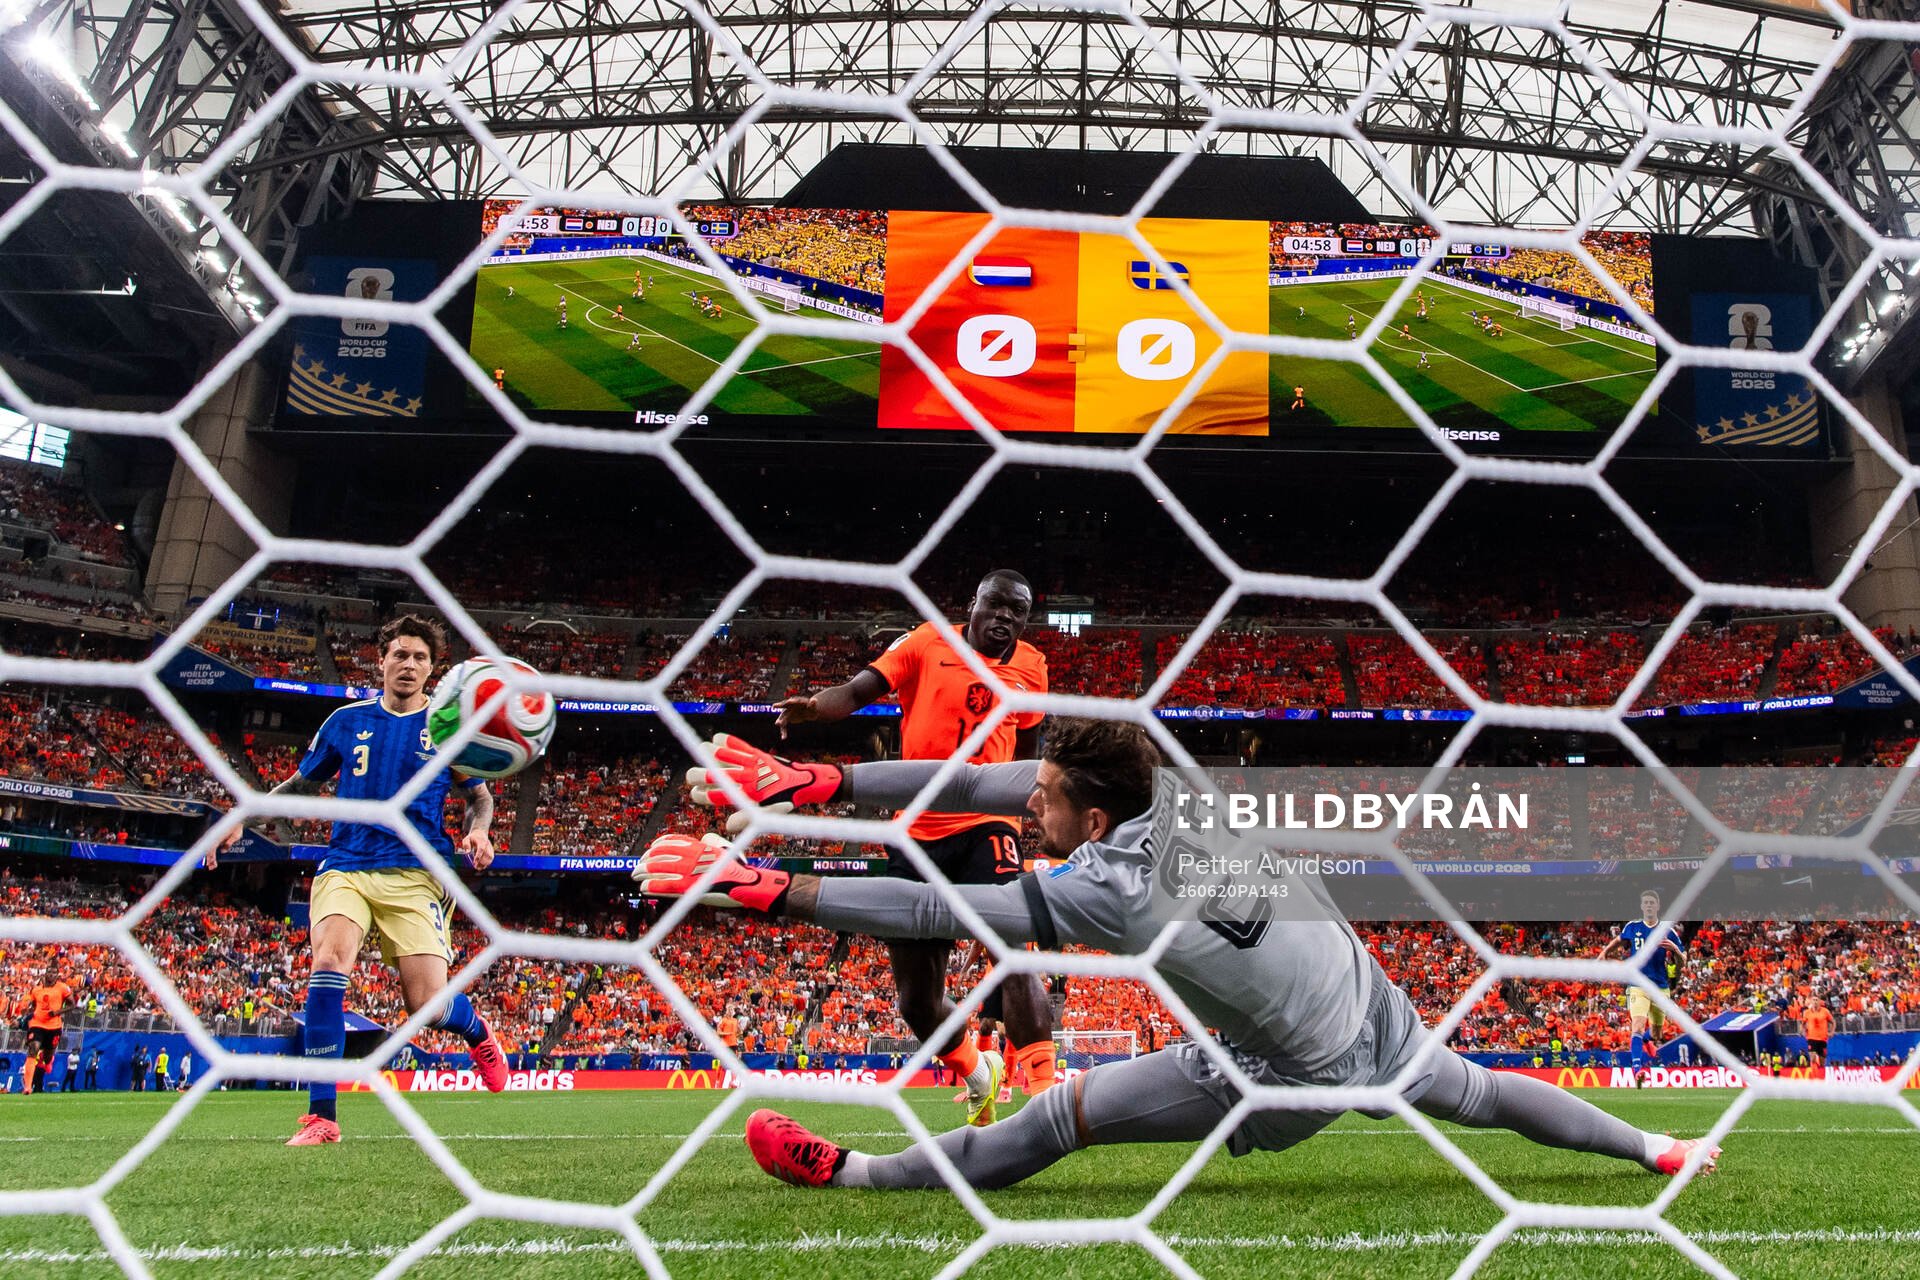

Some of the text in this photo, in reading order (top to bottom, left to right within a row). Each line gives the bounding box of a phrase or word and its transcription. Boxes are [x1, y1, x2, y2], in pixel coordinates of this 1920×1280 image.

[627, 221, 635, 232] 0
[660, 222, 668, 233] 0
[1292, 239, 1331, 251] 04:58
[1404, 243, 1412, 253] 0
[1451, 243, 1473, 254] SWE
[354, 322, 377, 331] FIFA
[340, 338, 388, 347] WORLD CUP
[956, 314, 1037, 377] 0
[337, 347, 387, 358] 2026
[1116, 318, 1196, 381] 0
[1731, 371, 1759, 379] WORLD
[1731, 379, 1776, 390] 2026
[222, 628, 256, 640] WORLD
[256, 633, 276, 642] CUP
[194, 663, 212, 672] FIFA
[179, 670, 226, 679] WORLD CUP
[1859, 689, 1886, 697] WORLD
[560, 701, 579, 710] FIFA
[580, 701, 611, 711] WORLD
[612, 702, 630, 711] CUP
[1793, 698, 1809, 708] CUP
[1160, 709, 1178, 717] FIFA
[1332, 711, 1374, 719] HOUSTON
[352, 744, 370, 777] 3
[23, 783, 42, 794] CUP
[42, 786, 73, 799] 2026
[988, 834, 1020, 865] 19
[560, 858, 642, 869] FIFA WORLD CU
[813, 860, 868, 870] HOUSTON
[1434, 863, 1472, 873] WORLD
[1473, 863, 1494, 873] CUP
[1495, 863, 1531, 874] 2026
[428, 901, 444, 932] 3
[1634, 937, 1645, 951] 21
